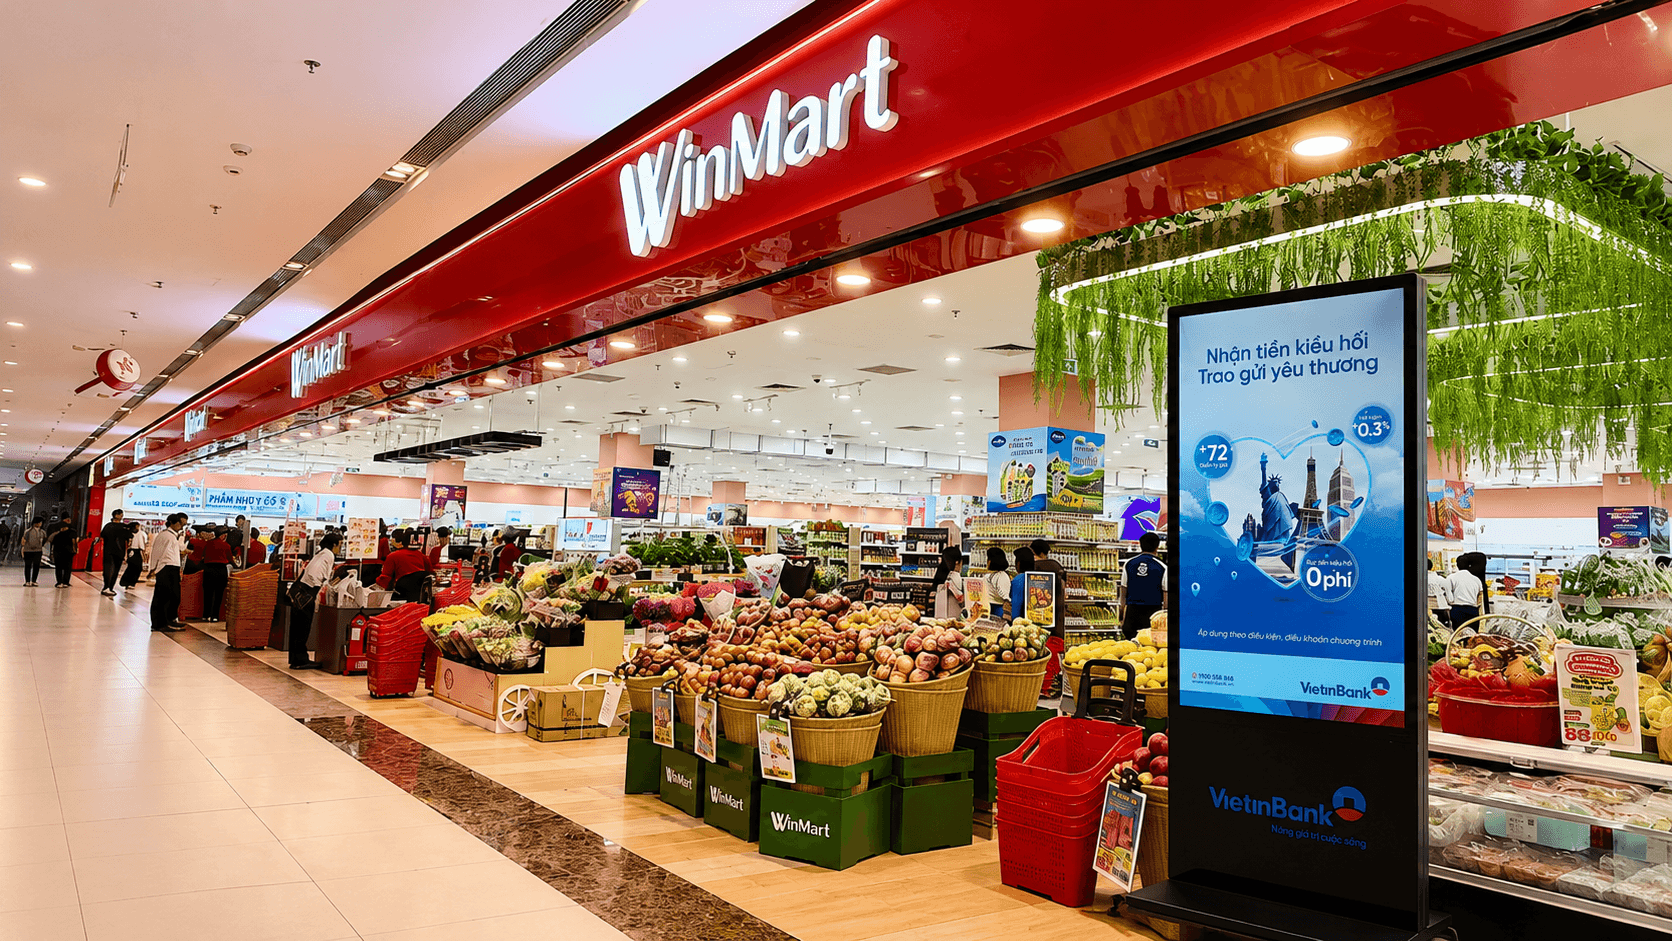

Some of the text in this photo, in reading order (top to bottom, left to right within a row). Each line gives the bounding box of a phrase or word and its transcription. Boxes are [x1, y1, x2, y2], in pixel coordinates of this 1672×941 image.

[619, 33, 897, 257] WinMart
[1207, 330, 1369, 366] Nhận tiền kiều hối
[291, 331, 345, 398] WinMart
[1198, 357, 1378, 386] Trao gửi yêu thương
[1200, 444, 1228, 462] +72
[1306, 566, 1352, 592] 0 phí
[1300, 681, 1372, 700] VietinBank
[665, 765, 693, 791] WinMart
[709, 785, 744, 811] WinMart
[1208, 785, 1334, 827] VietinBank
[770, 811, 830, 838] WinMart
